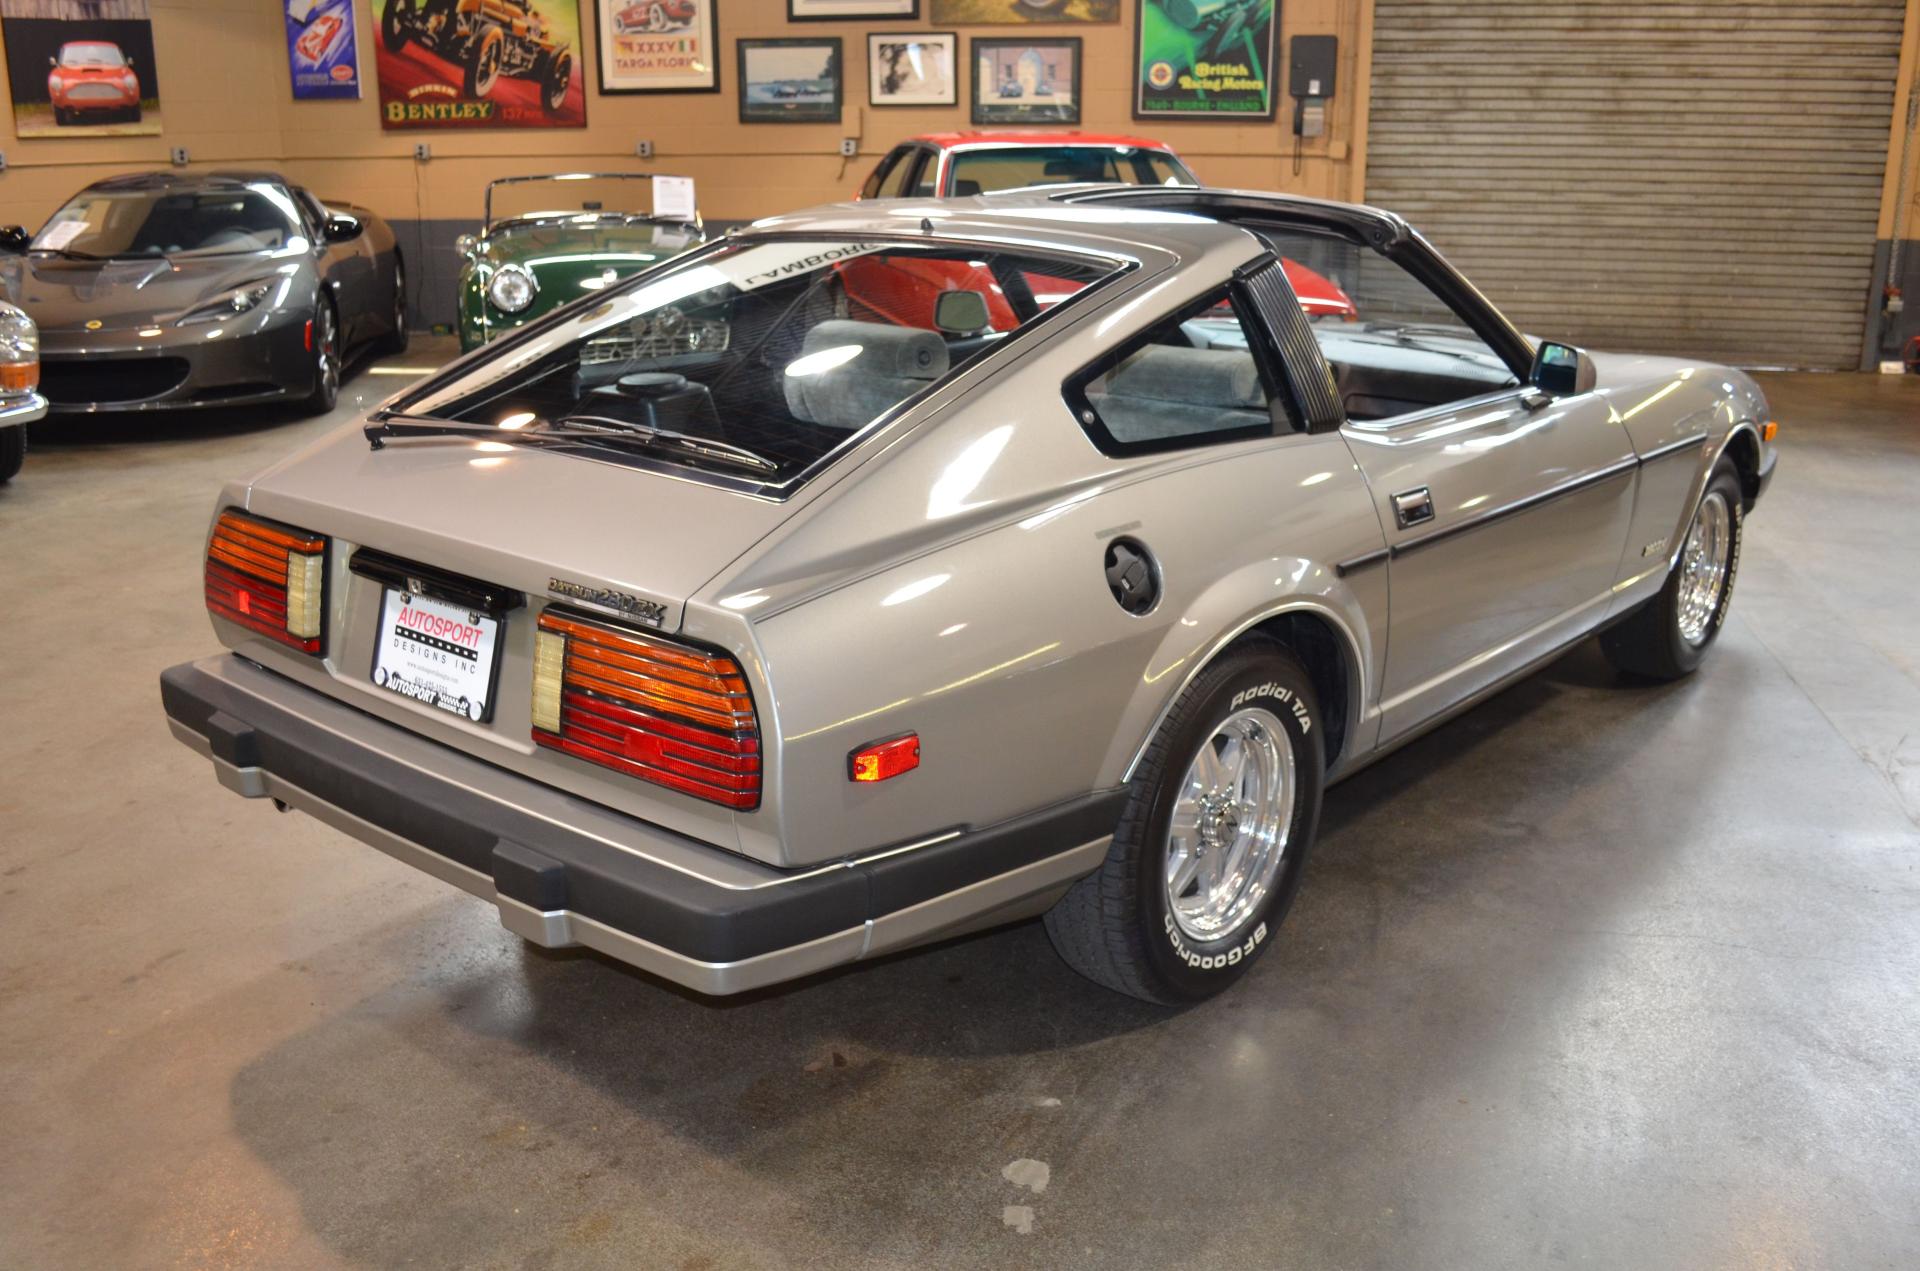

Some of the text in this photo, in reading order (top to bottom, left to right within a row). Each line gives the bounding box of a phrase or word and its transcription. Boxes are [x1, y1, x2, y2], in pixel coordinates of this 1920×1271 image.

[616, 59, 654, 68] TARGA
[1195, 62, 1249, 77] British
[1179, 76, 1264, 92] Racing Motors
[387, 101, 490, 122] BENTLEY
[397, 606, 484, 648] AUTOSPORT
[393, 638, 477, 675] DESIGNS INC
[385, 678, 437, 704] AUTOSPORT
[1230, 682, 1312, 735] Radial T/A
[1164, 914, 1268, 969] BFGoodrich
